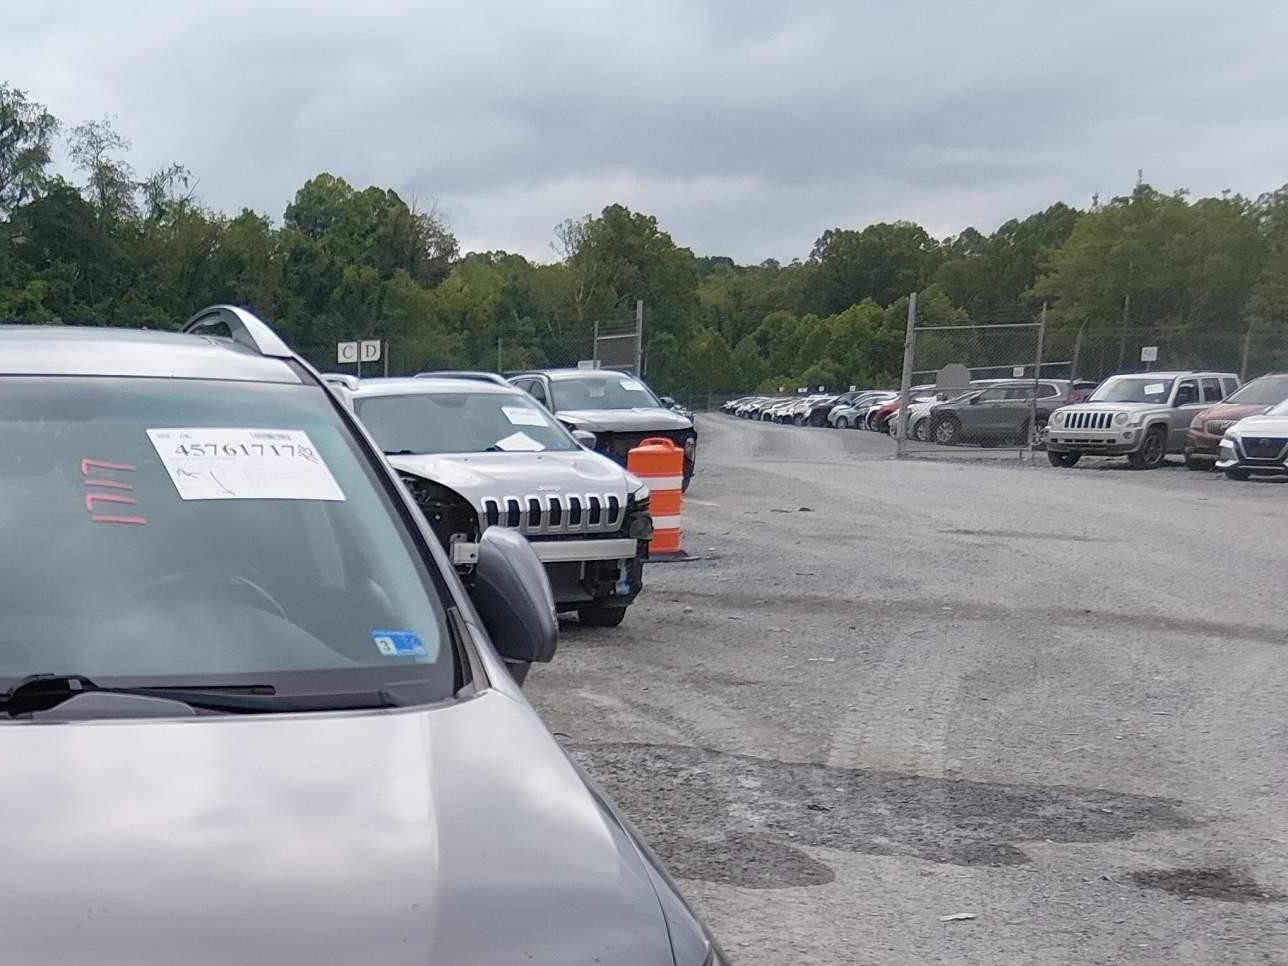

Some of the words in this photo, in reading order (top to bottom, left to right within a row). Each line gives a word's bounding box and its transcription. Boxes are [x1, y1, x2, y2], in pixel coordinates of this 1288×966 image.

[342, 344, 354, 360] C
[365, 344, 377, 358] D
[175, 443, 296, 457] 45761717
